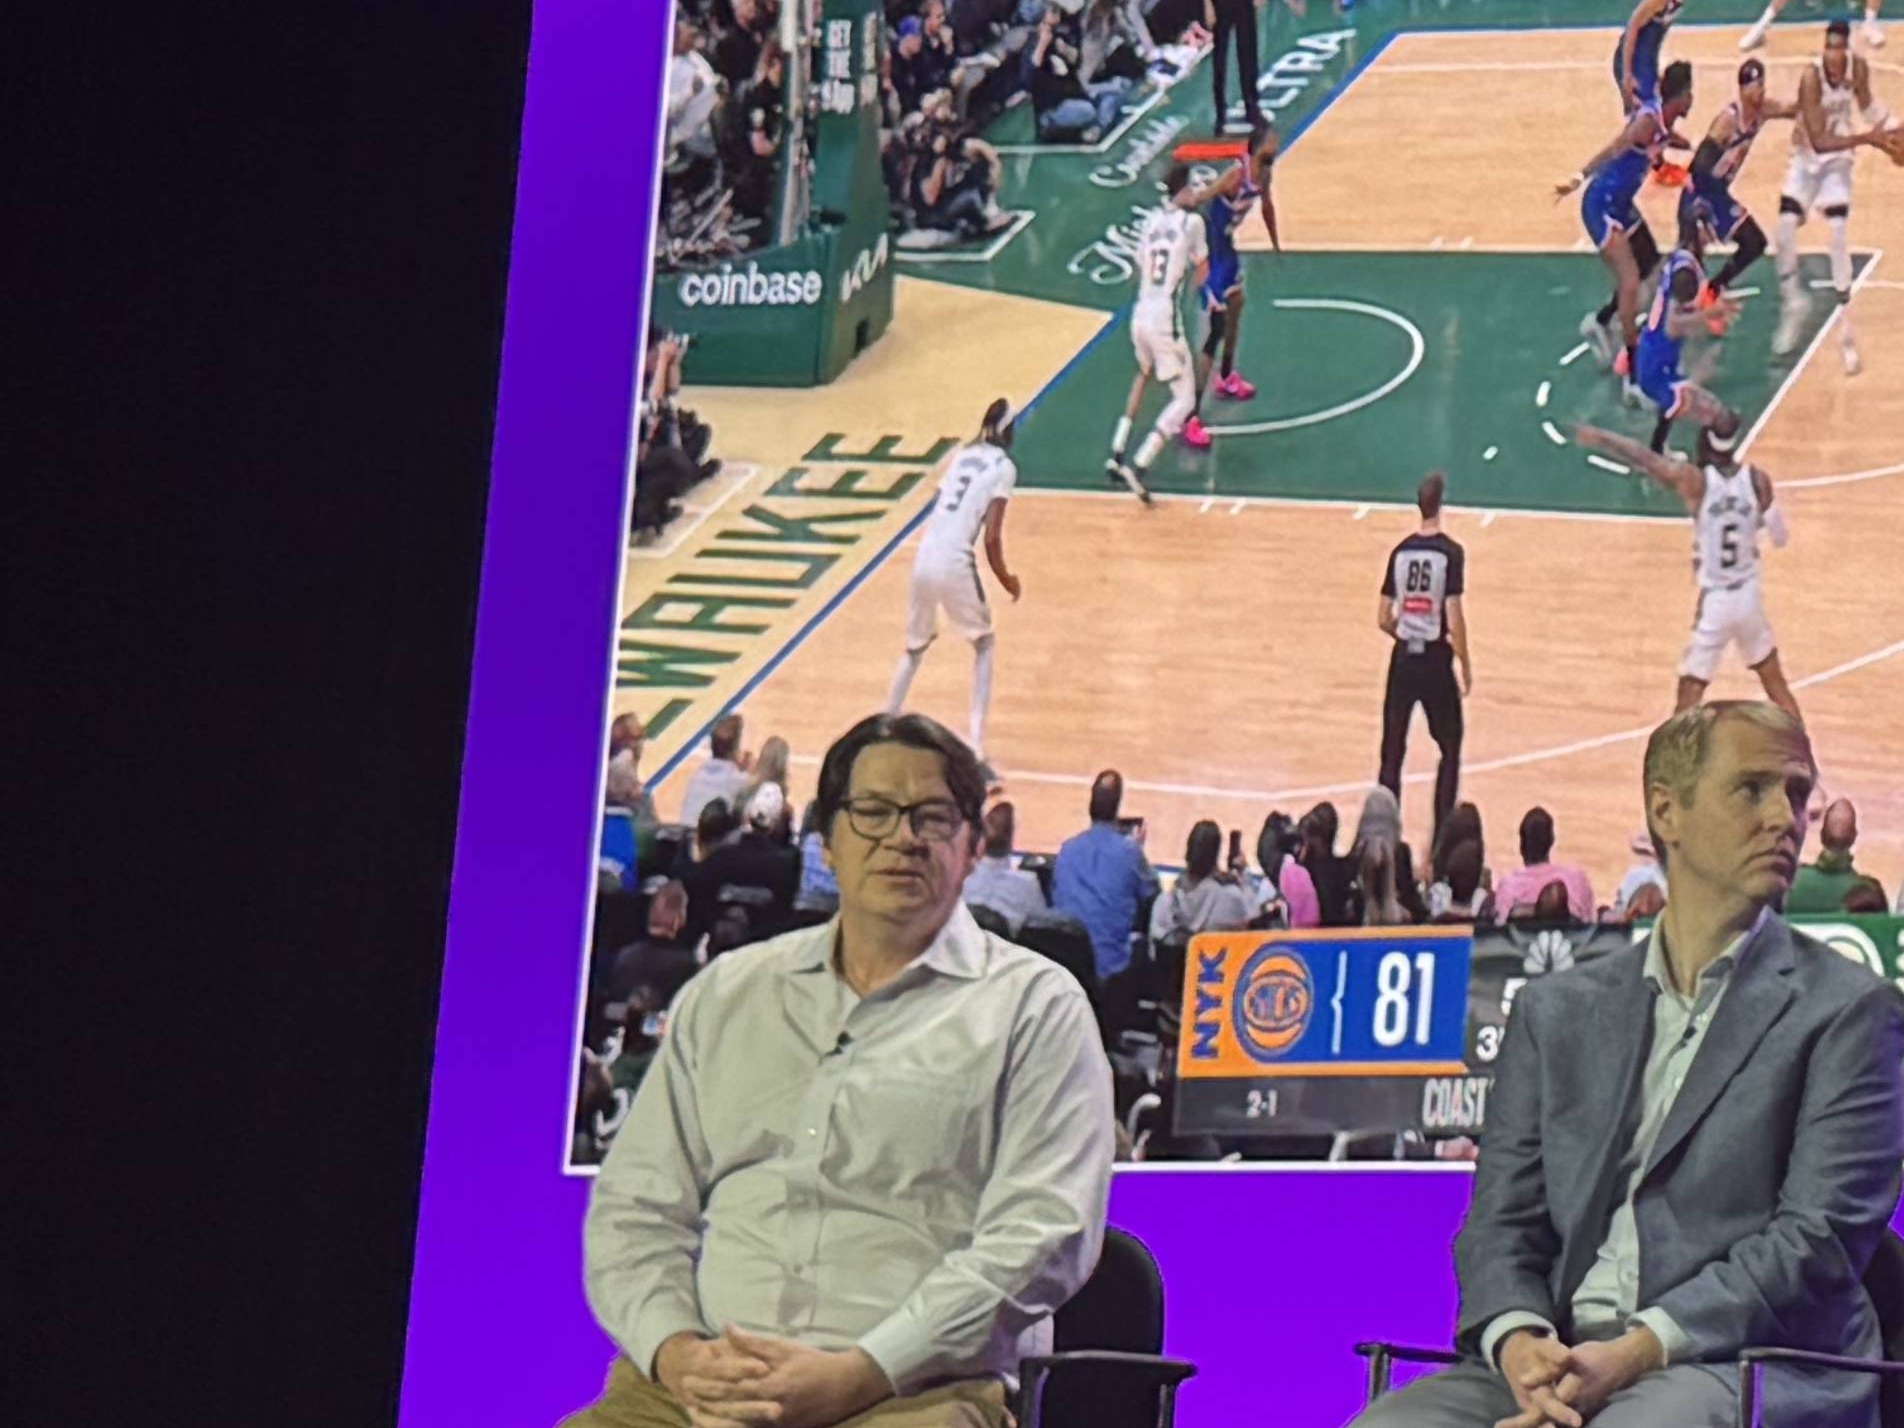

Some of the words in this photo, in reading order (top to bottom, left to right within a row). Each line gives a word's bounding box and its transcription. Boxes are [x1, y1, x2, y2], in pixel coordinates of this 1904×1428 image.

[680, 260, 823, 307] coinbase
[1721, 523, 1739, 568] 5
[615, 433, 962, 740] WAUKEE
[1406, 558, 1433, 592] 86
[1191, 946, 1229, 1060] NYK
[1372, 951, 1436, 1047] 81
[1422, 1078, 1489, 1129] COAST
